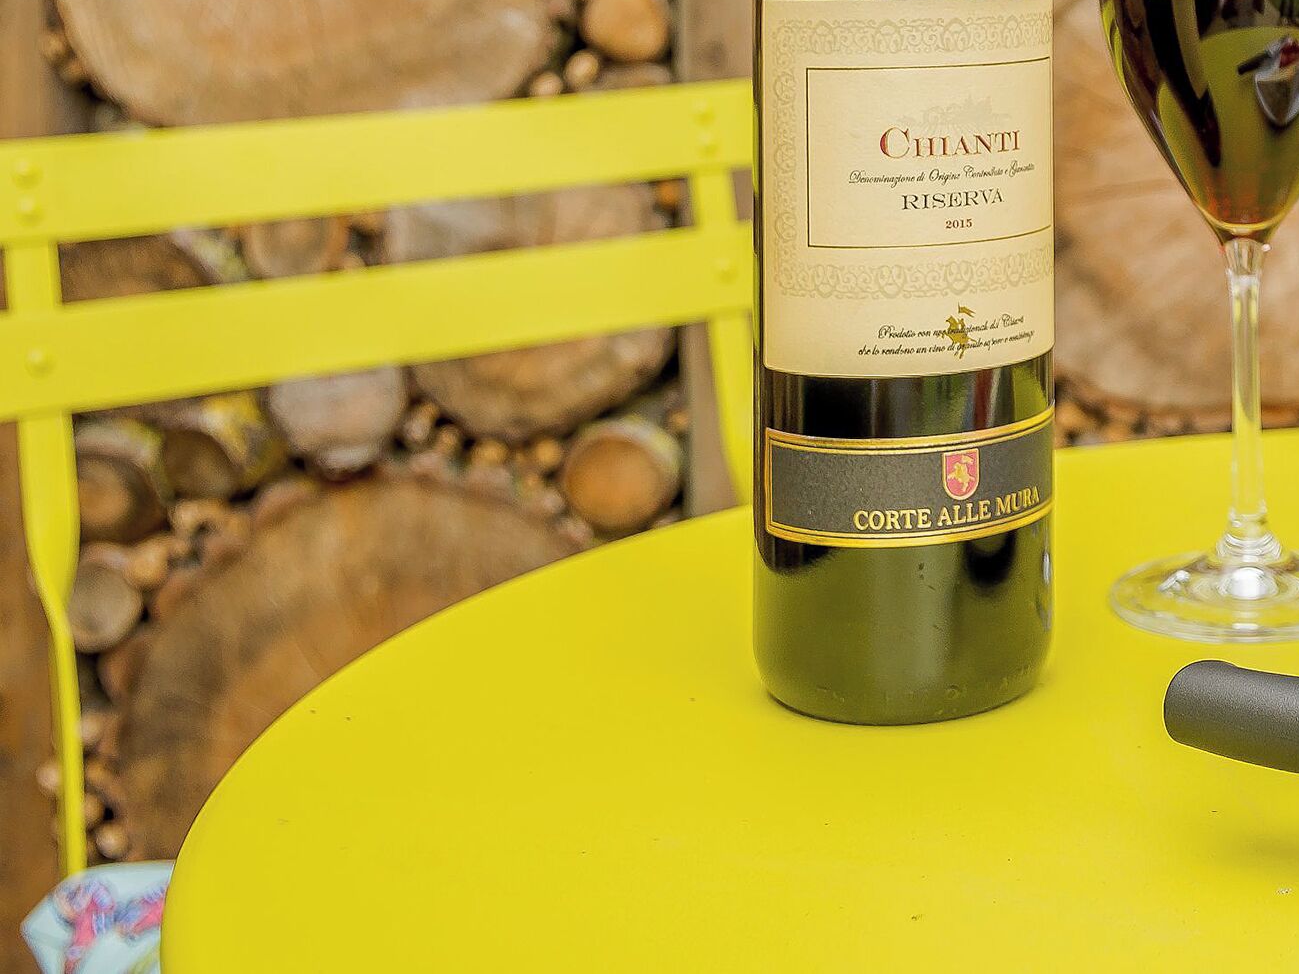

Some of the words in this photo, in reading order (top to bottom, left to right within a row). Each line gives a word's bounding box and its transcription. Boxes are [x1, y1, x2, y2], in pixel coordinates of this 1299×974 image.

[849, 169, 915, 188] Denominazione
[916, 171, 925, 182] di
[928, 168, 960, 186] Origine
[901, 188, 1005, 210] RISERVA
[945, 218, 973, 229] 2015
[853, 508, 932, 531] CORTE
[937, 499, 992, 527] ALLE
[995, 485, 1041, 515] MURA
